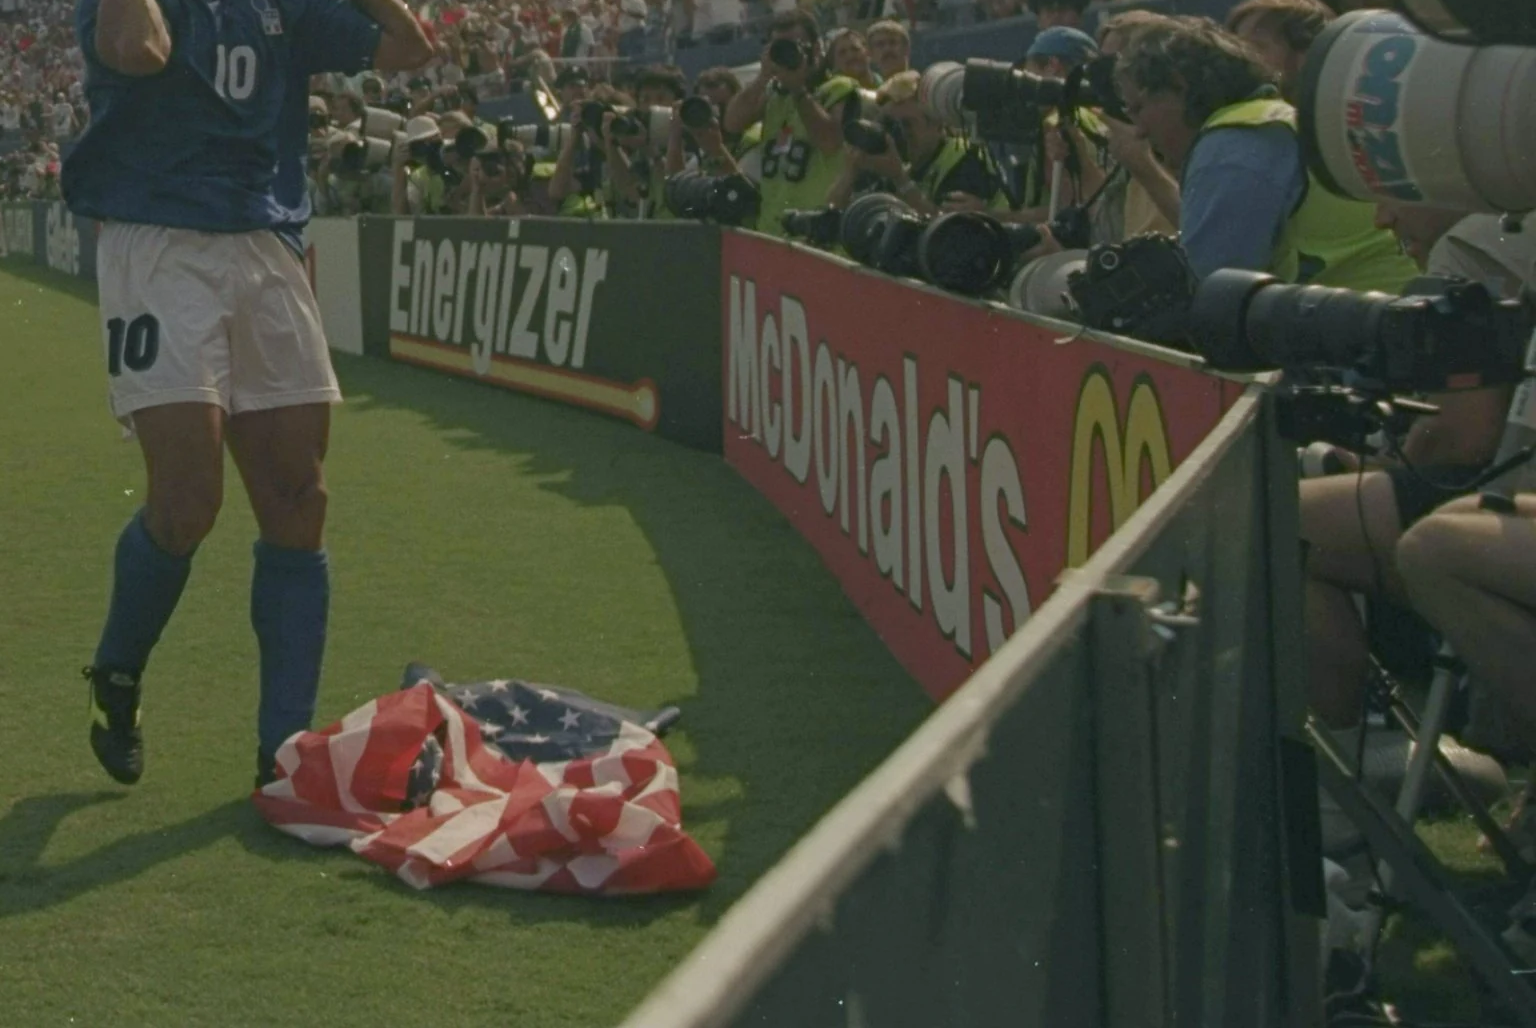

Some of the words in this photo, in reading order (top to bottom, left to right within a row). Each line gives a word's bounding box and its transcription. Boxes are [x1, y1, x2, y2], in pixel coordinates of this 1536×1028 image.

[215, 44, 257, 100] 10
[107, 314, 160, 377] 10
[389, 220, 609, 375] Energizer
[728, 275, 1031, 660] McDonald's
